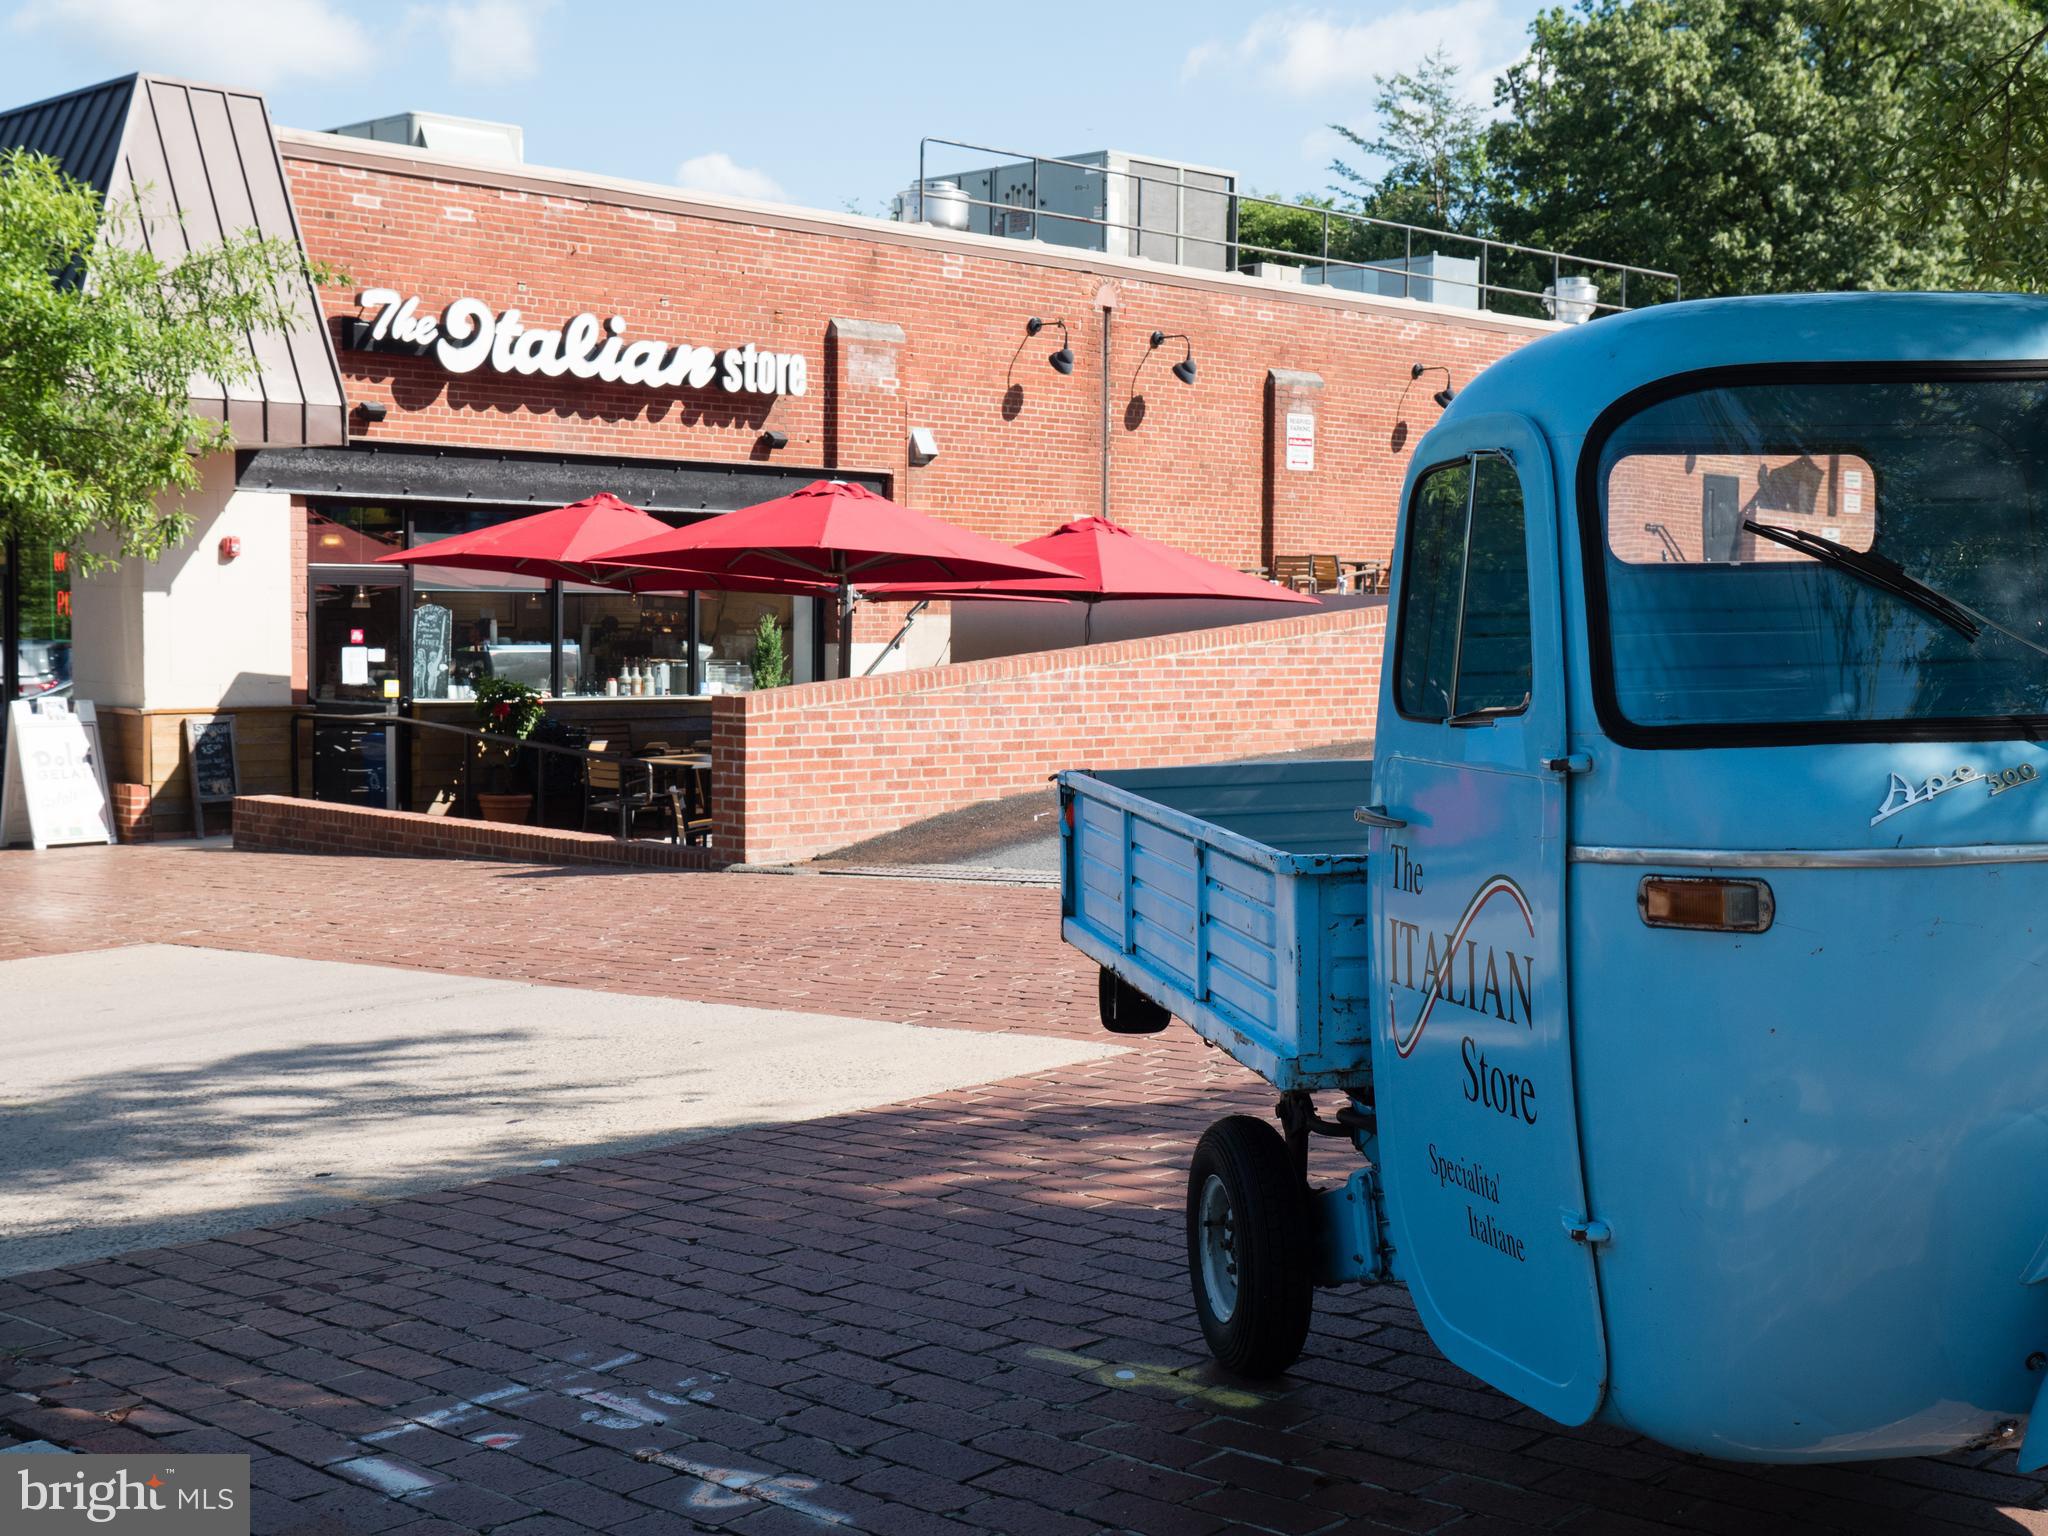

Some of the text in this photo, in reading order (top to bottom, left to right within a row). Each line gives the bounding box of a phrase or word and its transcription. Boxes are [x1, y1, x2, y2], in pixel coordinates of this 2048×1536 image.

[361, 288, 807, 396] The Italian store
[1986, 762, 2040, 796] 500
[1390, 844, 1424, 895] The
[1389, 918, 1534, 1030] ITALIAN
[1461, 1036, 1538, 1125] Store
[1466, 1205, 1526, 1262] Italiane
